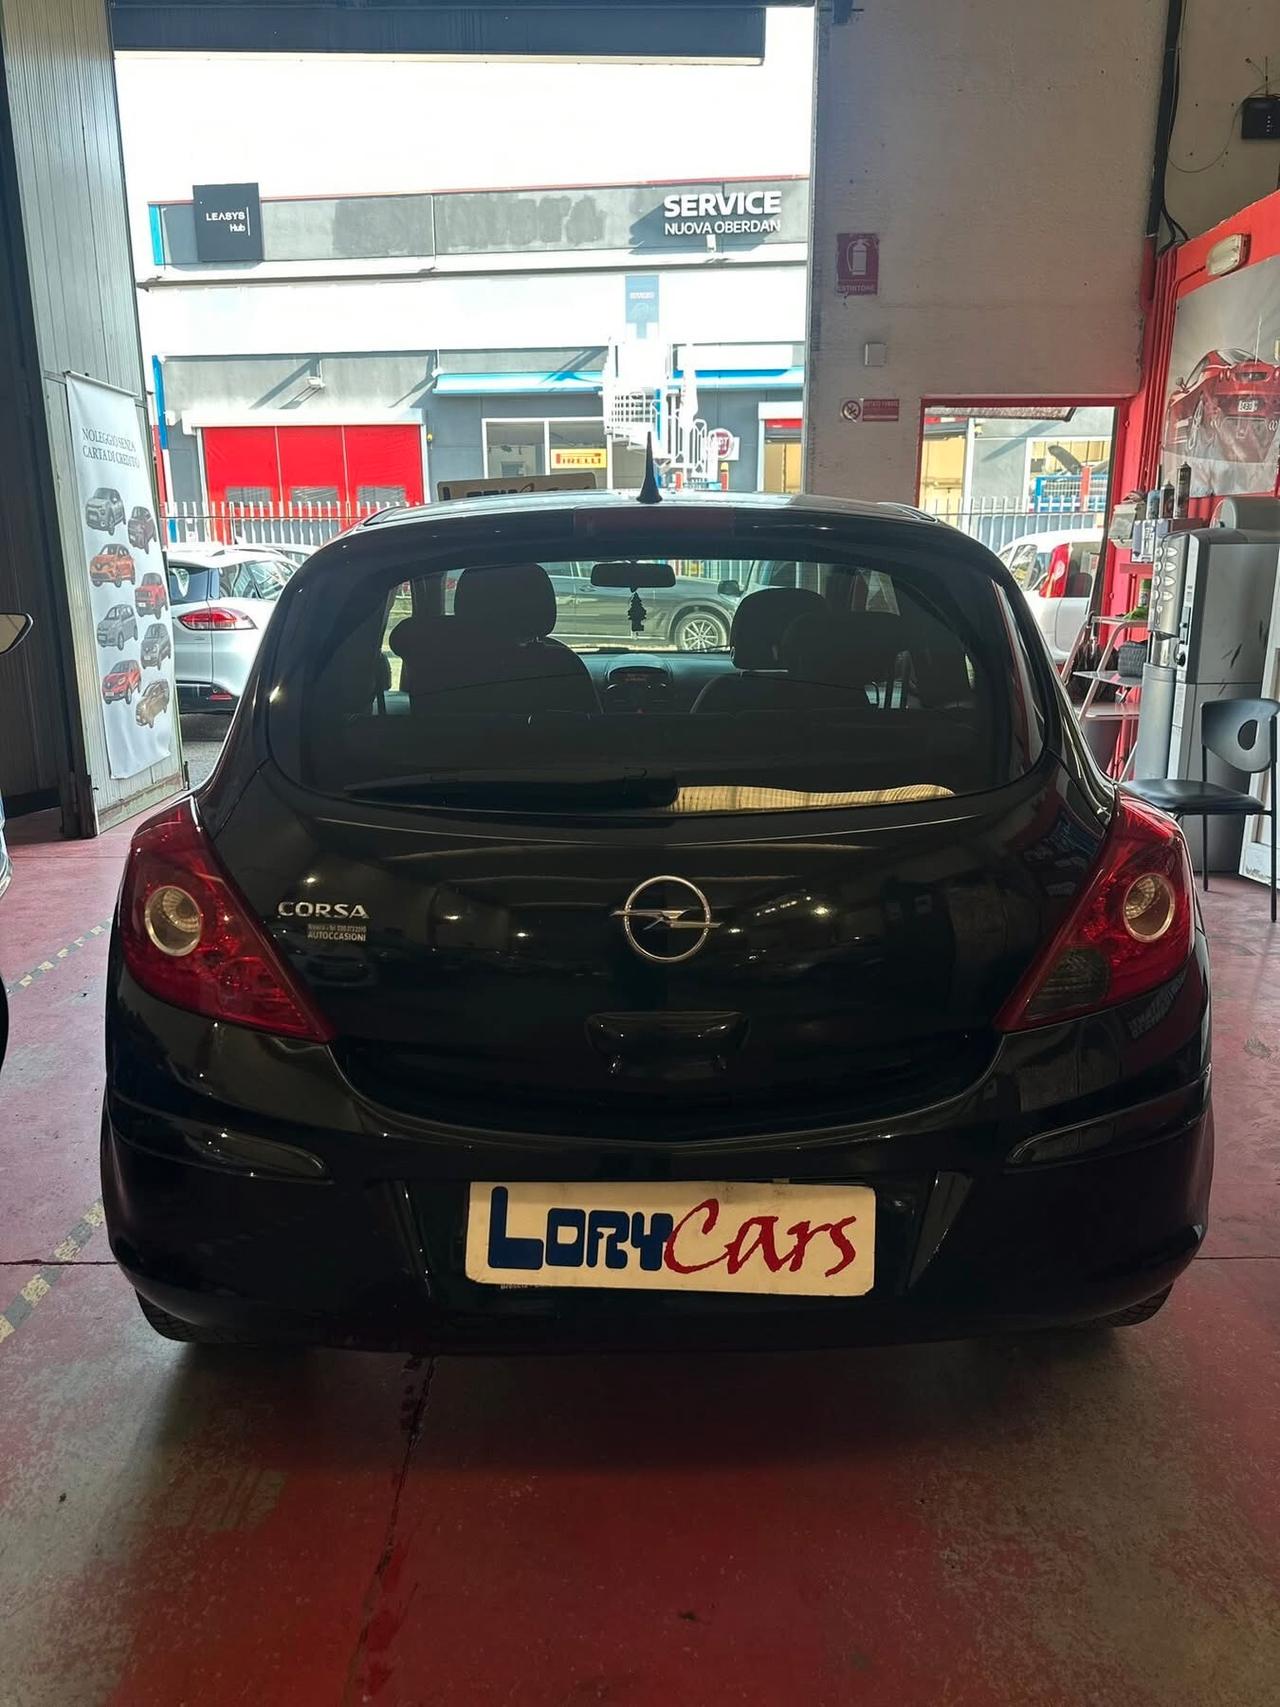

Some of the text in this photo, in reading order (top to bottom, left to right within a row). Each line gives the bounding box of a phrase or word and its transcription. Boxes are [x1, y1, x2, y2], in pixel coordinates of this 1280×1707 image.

[664, 191, 782, 217] SERVICE
[205, 211, 246, 221] LEASYS
[229, 223, 247, 233] Hub
[665, 219, 781, 236] NUOVA OBERDAN
[82, 445, 107, 461] CARTA
[555, 452, 602, 465] PIRELLI
[278, 901, 370, 919] CORSA
[307, 931, 366, 942] AUTOCCASIONI
